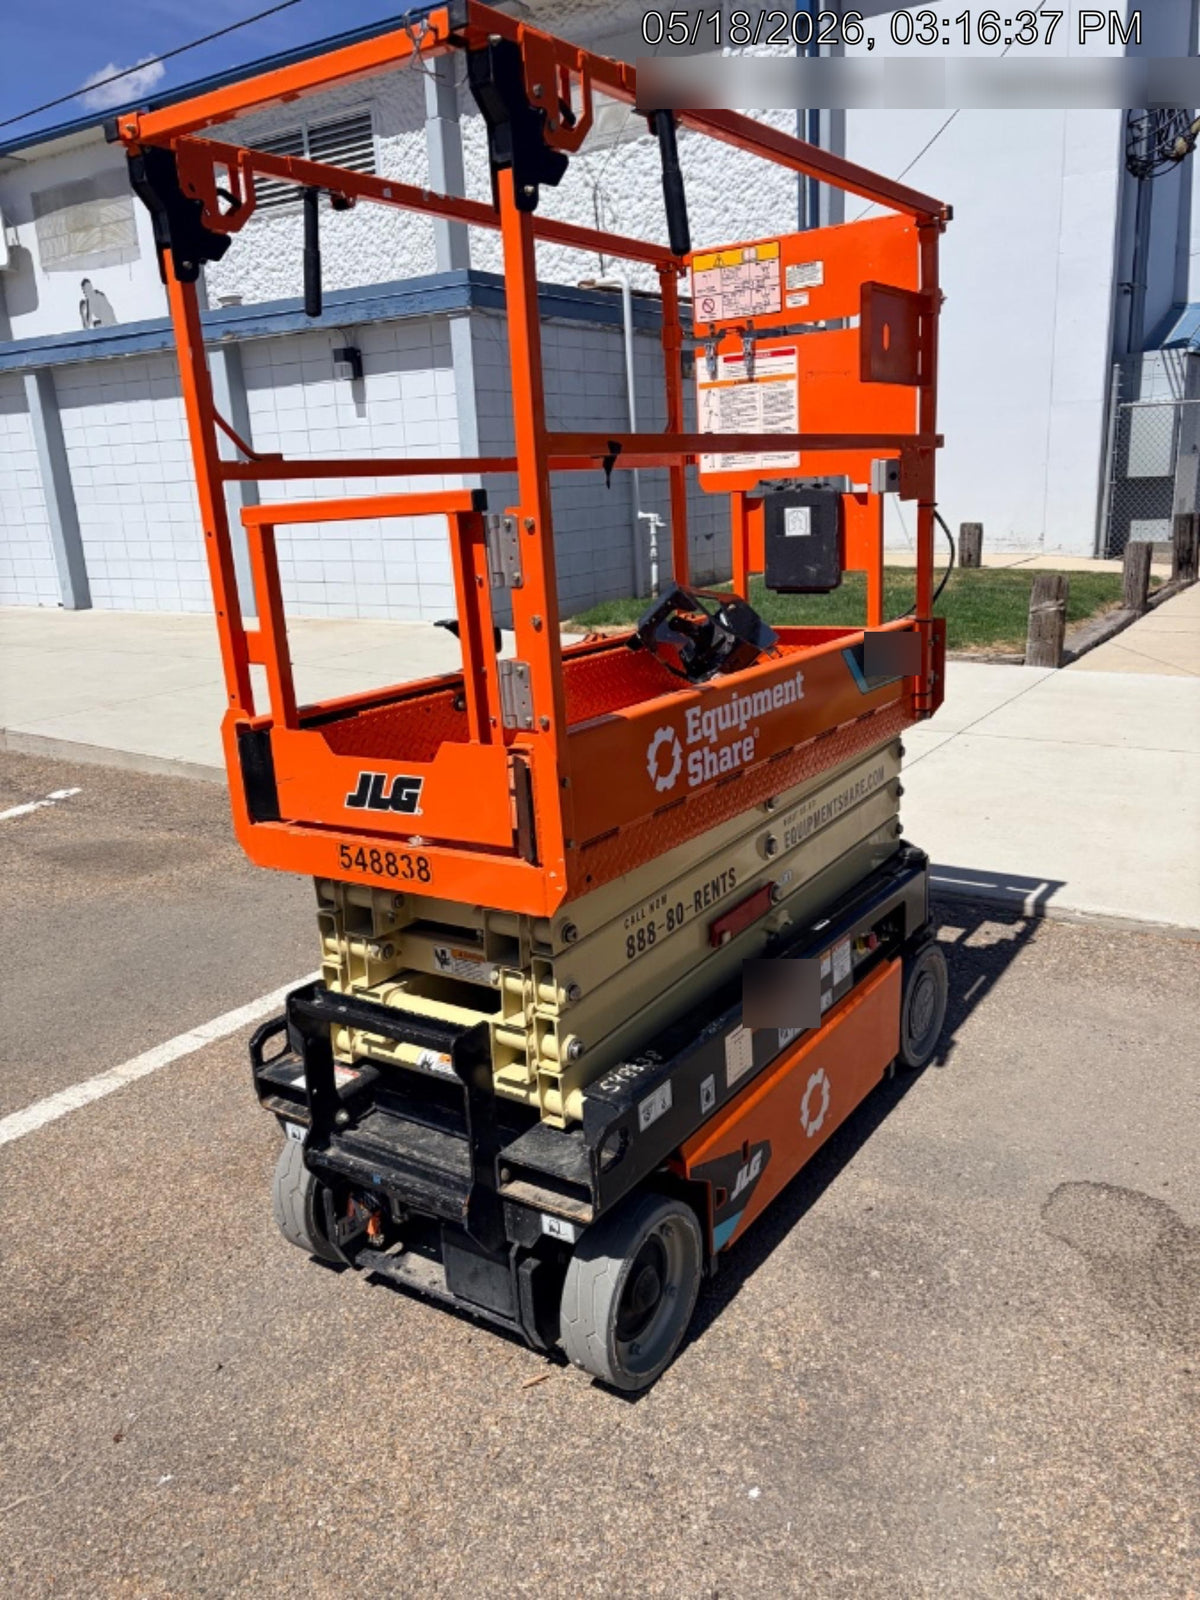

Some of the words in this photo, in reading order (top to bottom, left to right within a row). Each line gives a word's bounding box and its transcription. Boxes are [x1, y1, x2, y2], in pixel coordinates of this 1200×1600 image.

[685, 671, 804, 743] Equipment
[687, 733, 756, 787] Share
[344, 770, 423, 814] JLG
[340, 844, 431, 883] 548838
[626, 867, 737, 959] 888-80-RENTS
[730, 1149, 763, 1202] JLG
